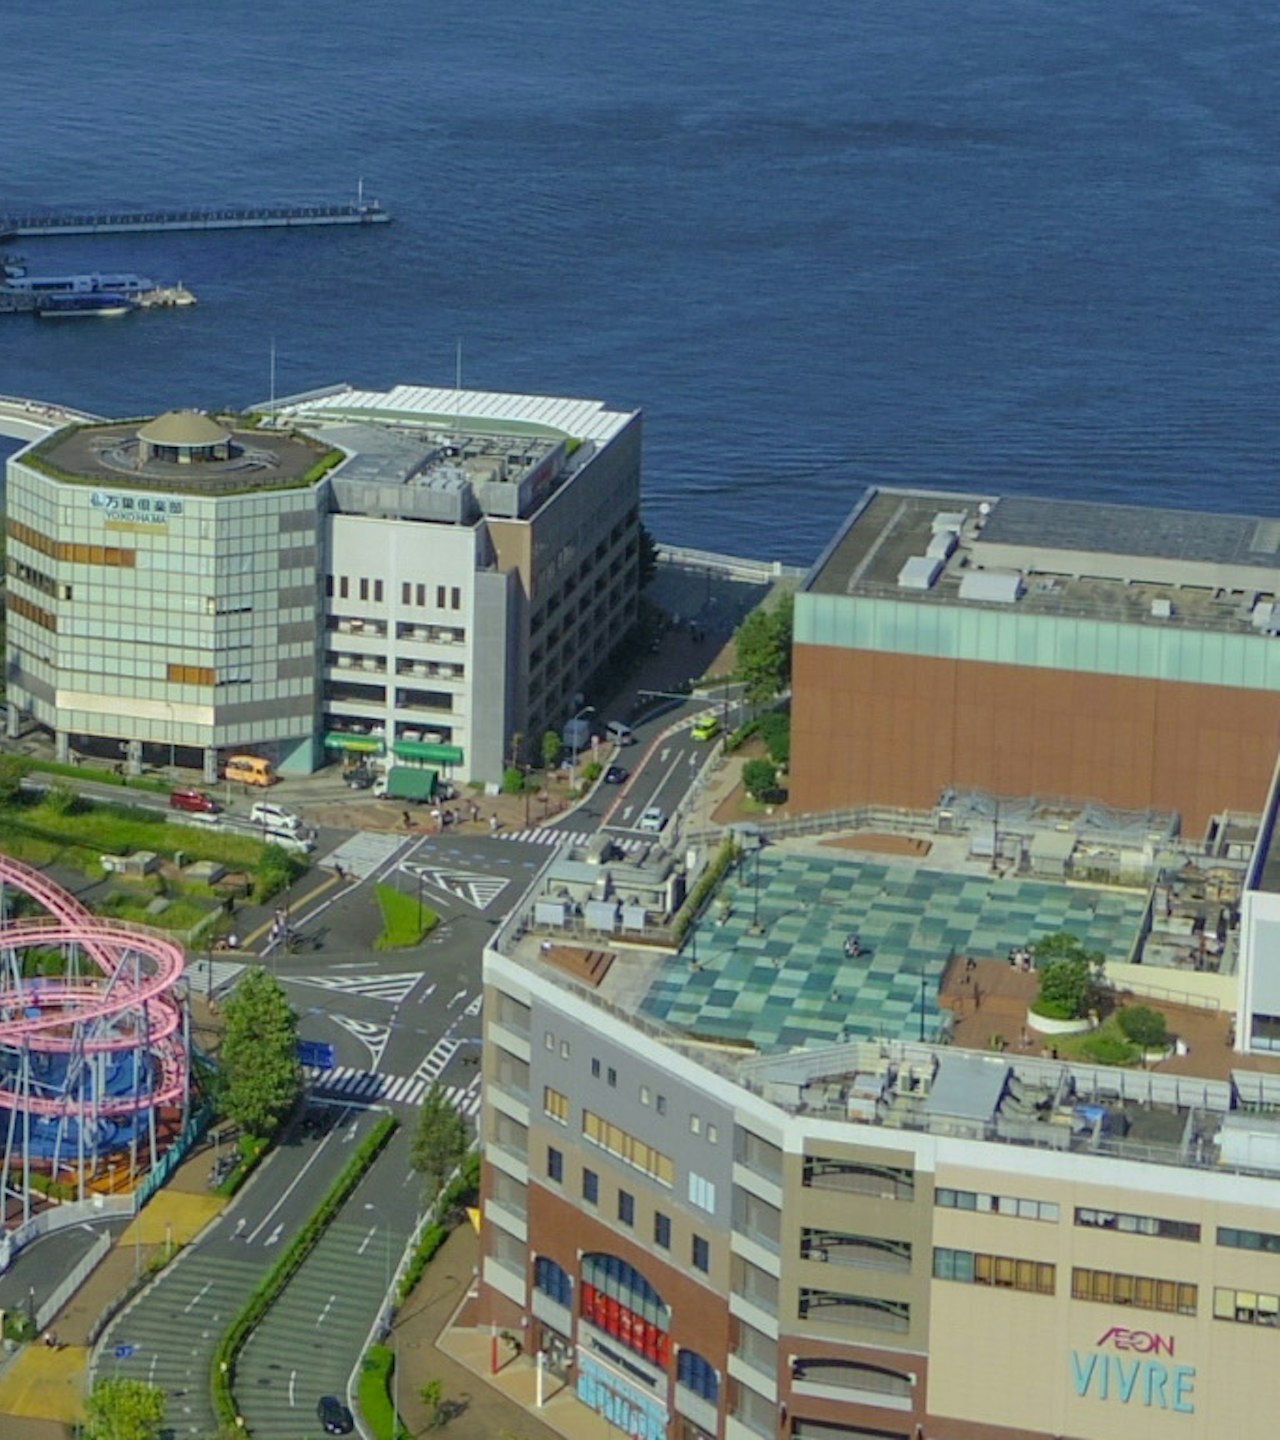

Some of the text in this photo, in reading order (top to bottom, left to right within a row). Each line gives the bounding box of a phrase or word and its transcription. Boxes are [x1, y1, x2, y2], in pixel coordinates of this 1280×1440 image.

[104, 509, 166, 523] YOKOHAMA
[1096, 1326, 1175, 1358] AEON
[1071, 1348, 1197, 1415] VIVRE
